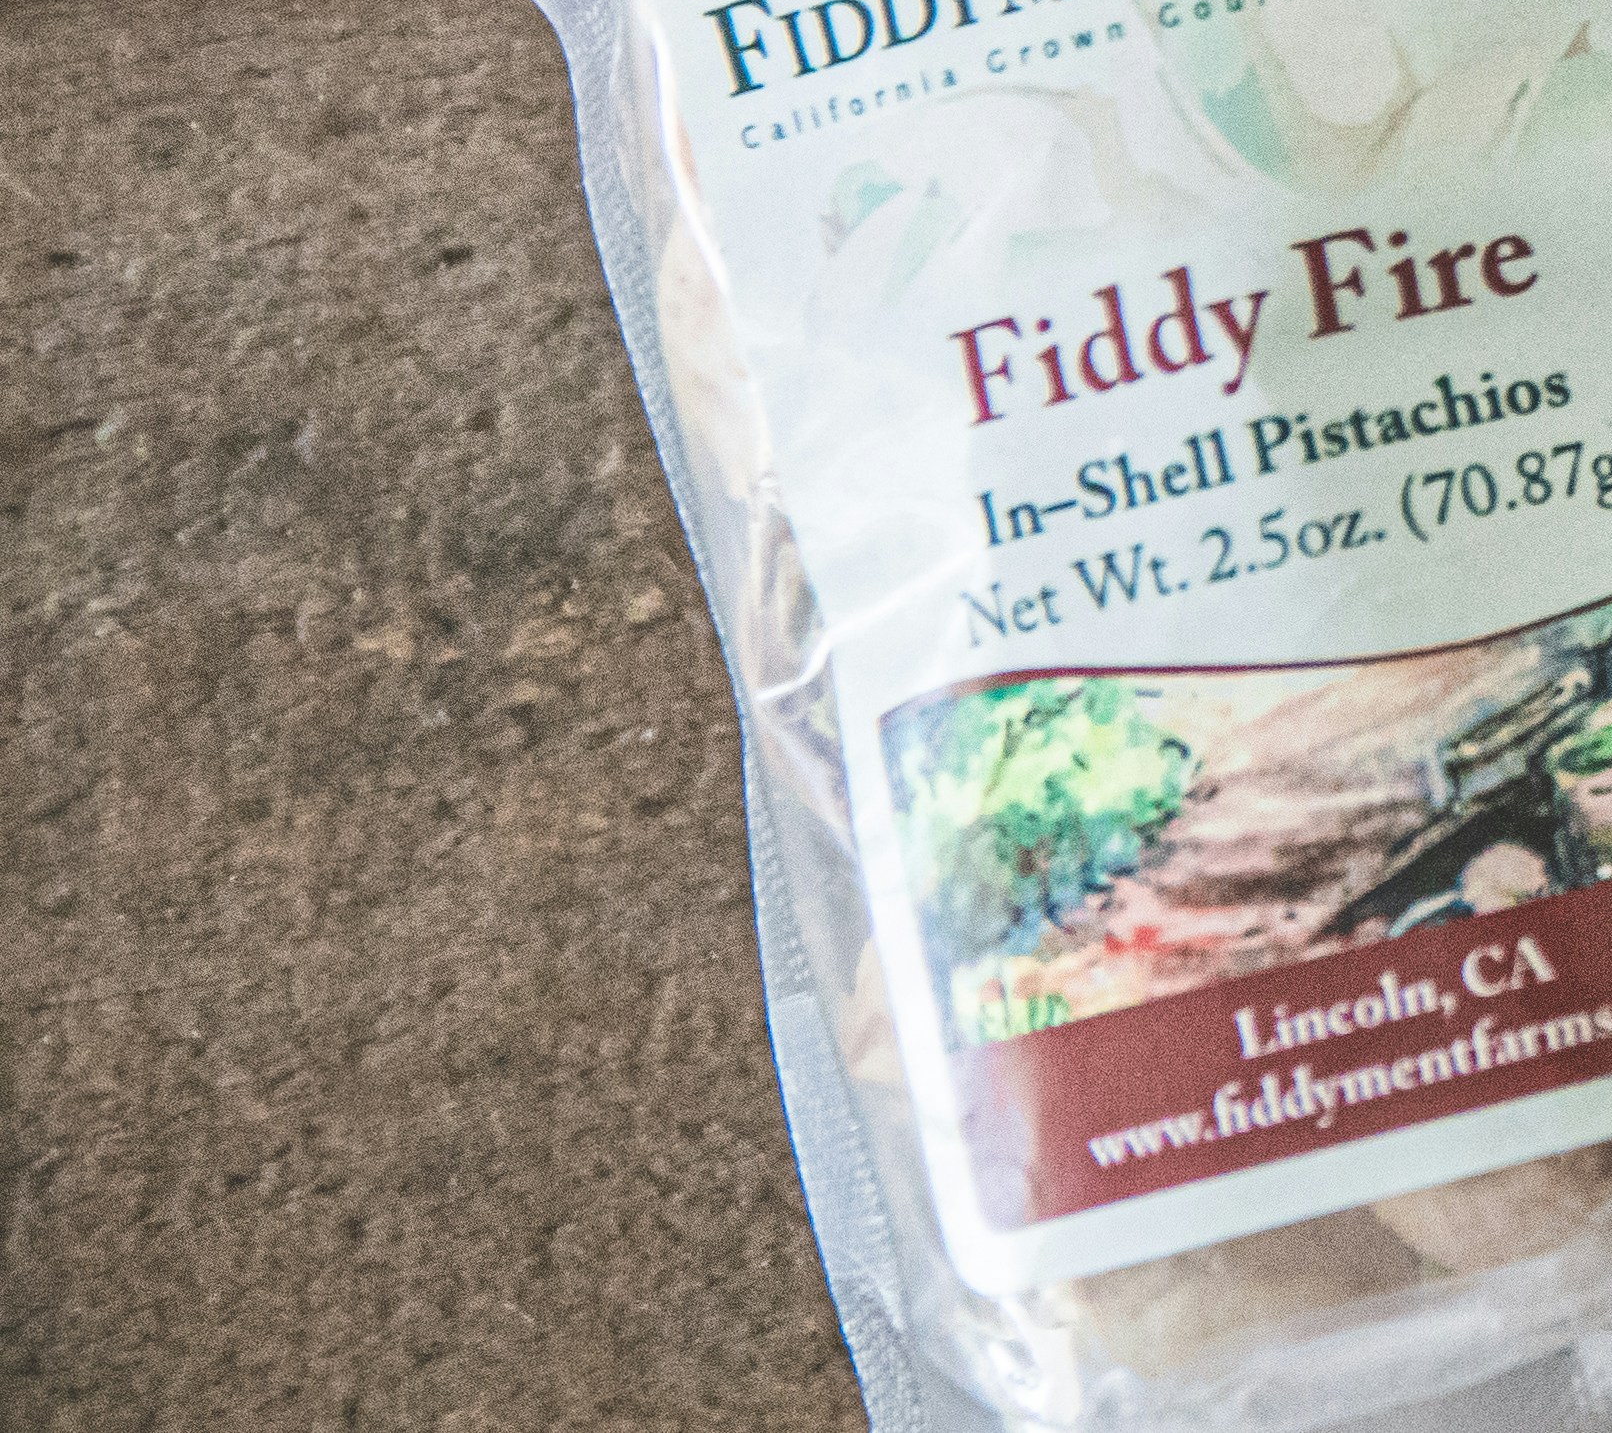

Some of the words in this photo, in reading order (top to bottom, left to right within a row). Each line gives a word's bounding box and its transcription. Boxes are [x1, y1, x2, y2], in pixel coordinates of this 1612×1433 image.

[740, 68, 959, 151] California
[987, 22, 1130, 74] Grown
[948, 266, 1269, 426] Fiddy
[1291, 224, 1540, 338] Fire
[1250, 366, 1573, 474] Pistachios
[960, 574, 1062, 650] Net
[1072, 544, 1191, 611] Wt.
[1204, 506, 1387, 583] 2.5oz.
[1233, 968, 1458, 1063] Lincoln,
[1461, 935, 1558, 998] CA
